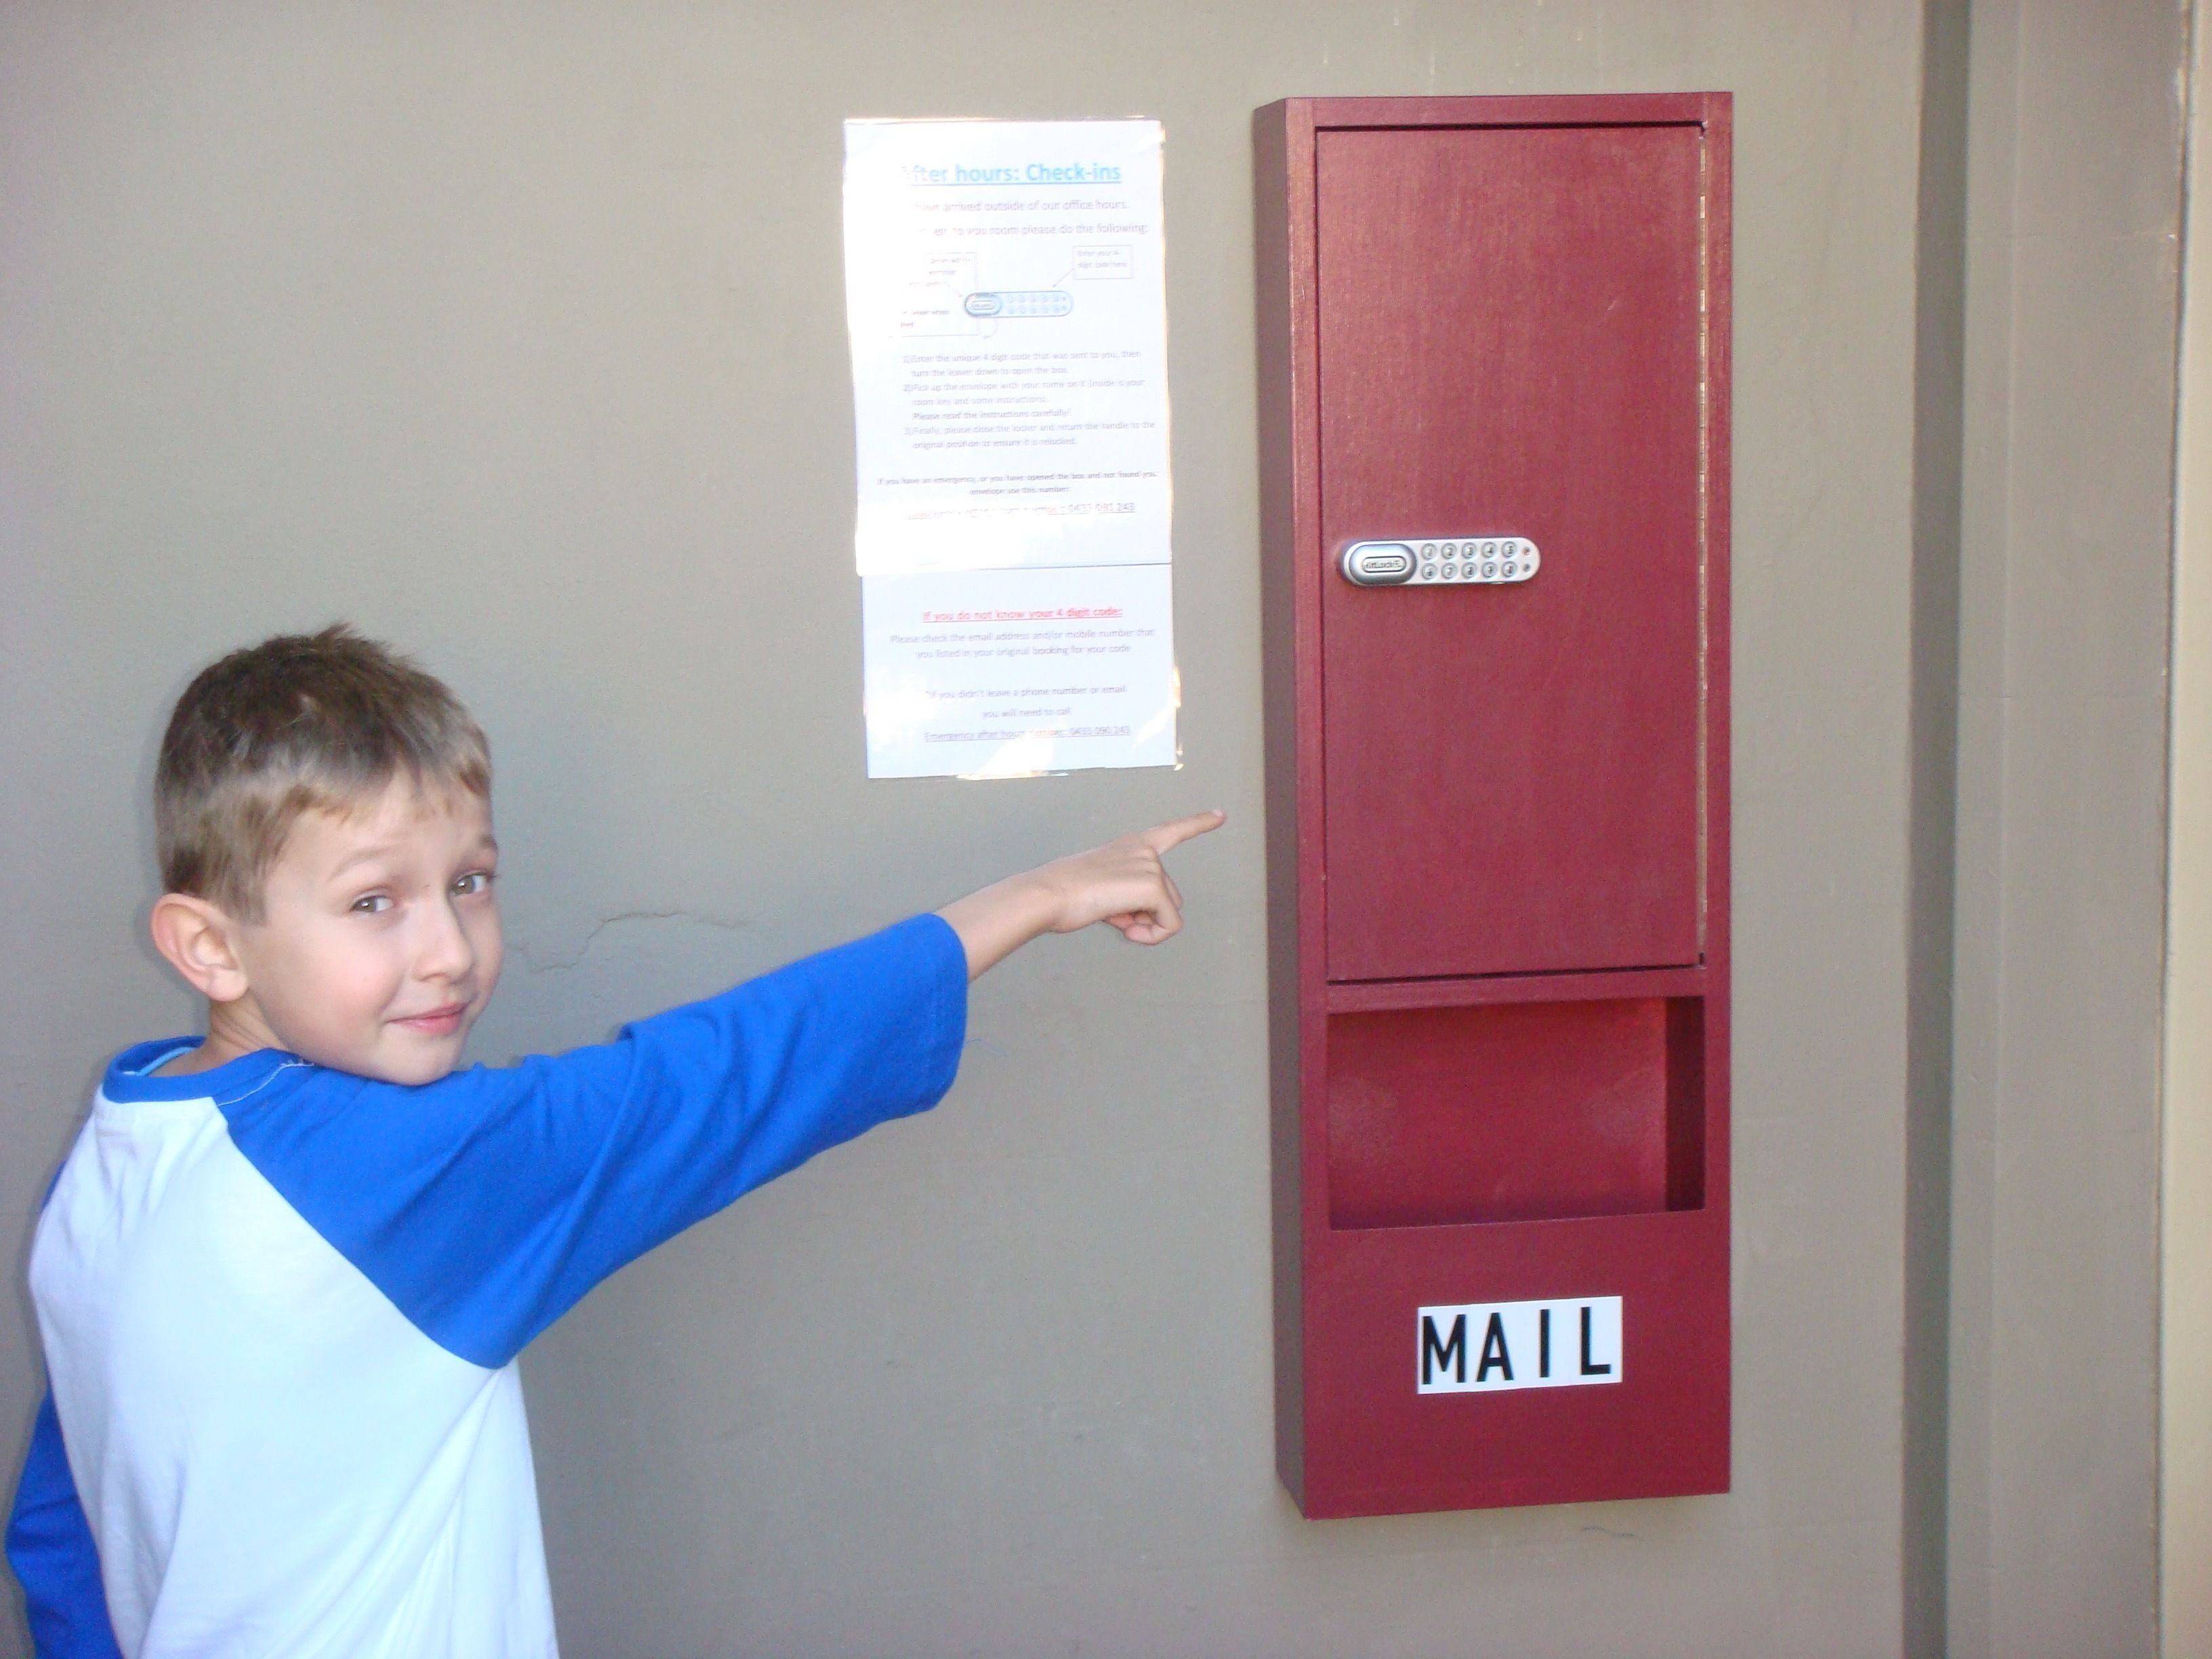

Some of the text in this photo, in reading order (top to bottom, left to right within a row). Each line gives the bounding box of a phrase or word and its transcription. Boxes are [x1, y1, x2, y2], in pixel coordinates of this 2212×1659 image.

[954, 163, 1020, 182] hours:
[1025, 162, 1122, 181] Check-ins
[943, 201, 982, 211] arrived
[984, 201, 1023, 211] outside
[1027, 200, 1040, 210] of
[1041, 202, 1059, 210] our
[1062, 199, 1092, 209] office
[989, 226, 1019, 234] room
[1021, 224, 1057, 234] please
[1059, 224, 1073, 234] do
[1076, 223, 1094, 233] the
[922, 611, 933, 621] If
[933, 613, 954, 621] you
[956, 610, 972, 620] do
[974, 610, 994, 619] not
[996, 608, 1025, 618] know
[1029, 610, 1054, 619] your
[1067, 607, 1090, 618] digit
[889, 634, 920, 643] Please
[922, 634, 947, 642] check
[949, 633, 965, 641] the
[968, 632, 993, 641] email
[996, 631, 1030, 640] address
[1067, 630, 1097, 638] mobile
[1099, 628, 1134, 637] number
[1135, 628, 1155, 636] that
[1422, 1306, 1611, 1385] MAIL
